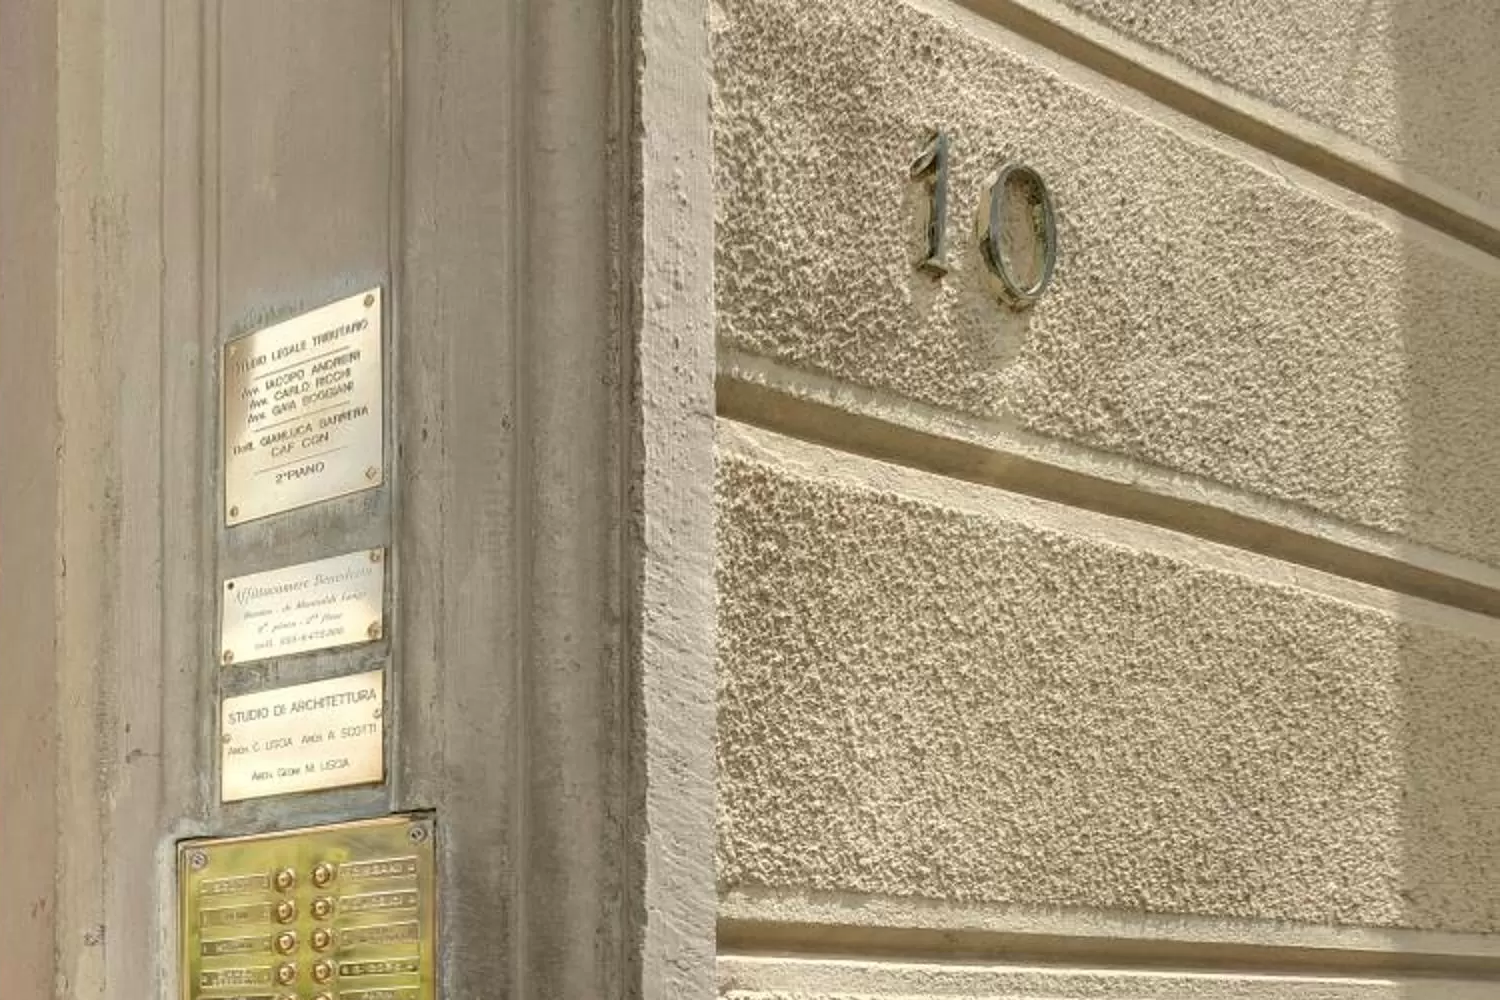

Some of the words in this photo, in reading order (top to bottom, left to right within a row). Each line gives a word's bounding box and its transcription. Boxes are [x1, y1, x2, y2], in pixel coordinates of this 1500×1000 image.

[909, 127, 1057, 312] 10
[271, 339, 308, 362] LEGALE
[228, 707, 270, 726] STUDIO
[289, 688, 377, 714] ARCHITETTURA
